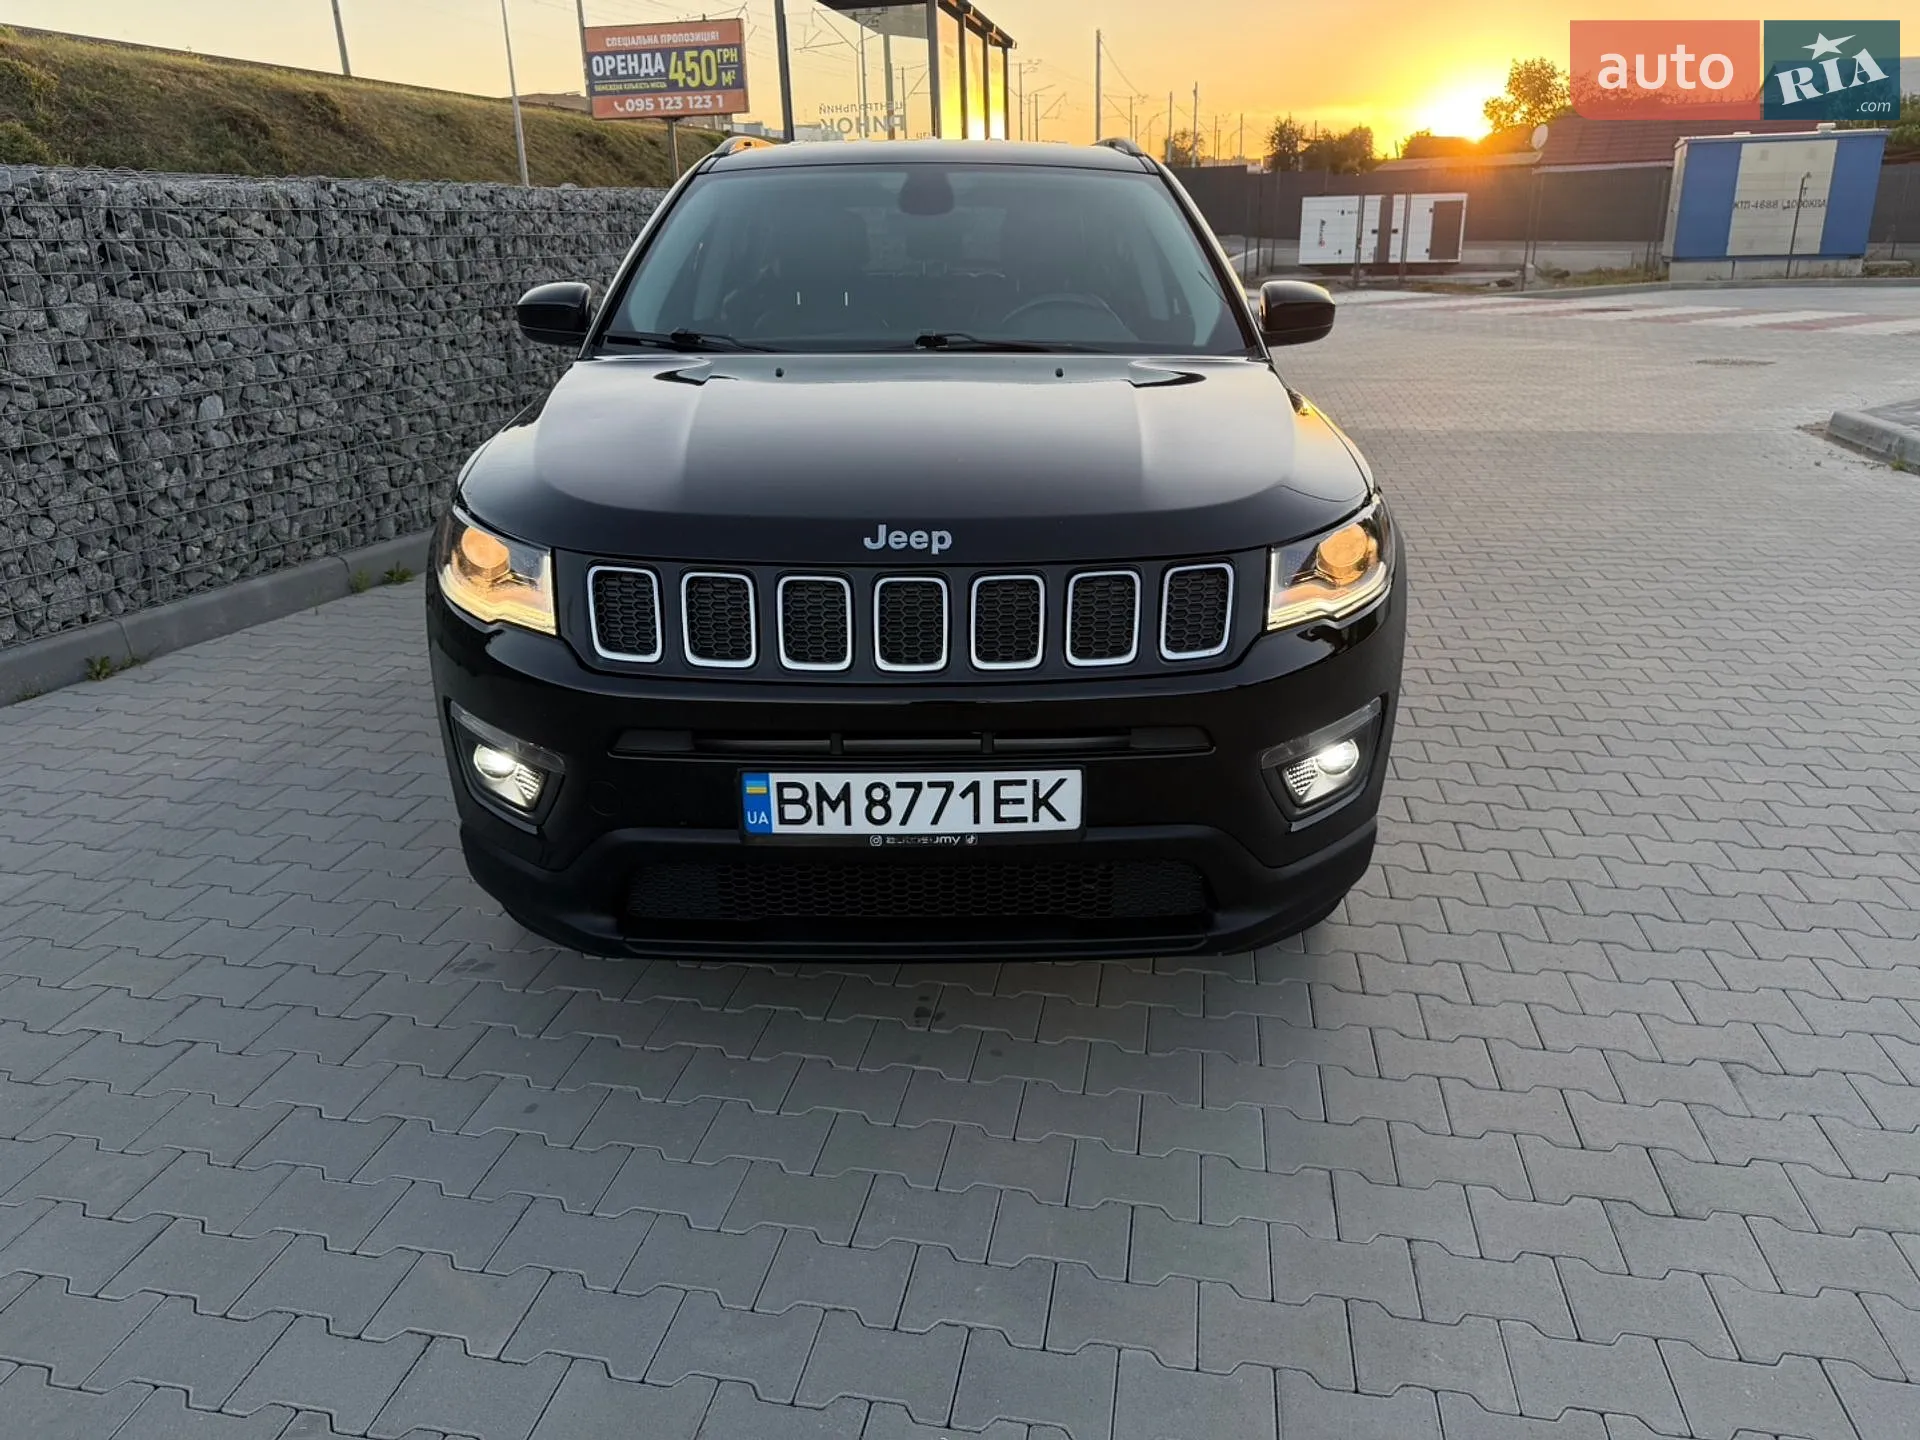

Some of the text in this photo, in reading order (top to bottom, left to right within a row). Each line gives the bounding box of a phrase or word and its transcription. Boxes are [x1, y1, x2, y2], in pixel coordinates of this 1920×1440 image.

[606, 33, 659, 48] СПЕЦІАЛЬНА
[592, 48, 738, 88] ОРЕНДА 450 ГРН
[625, 98, 654, 112] 095
[657, 96, 683, 110] 123
[687, 95, 713, 109] 123
[863, 524, 952, 554] Jeep
[747, 811, 769, 825] UA
